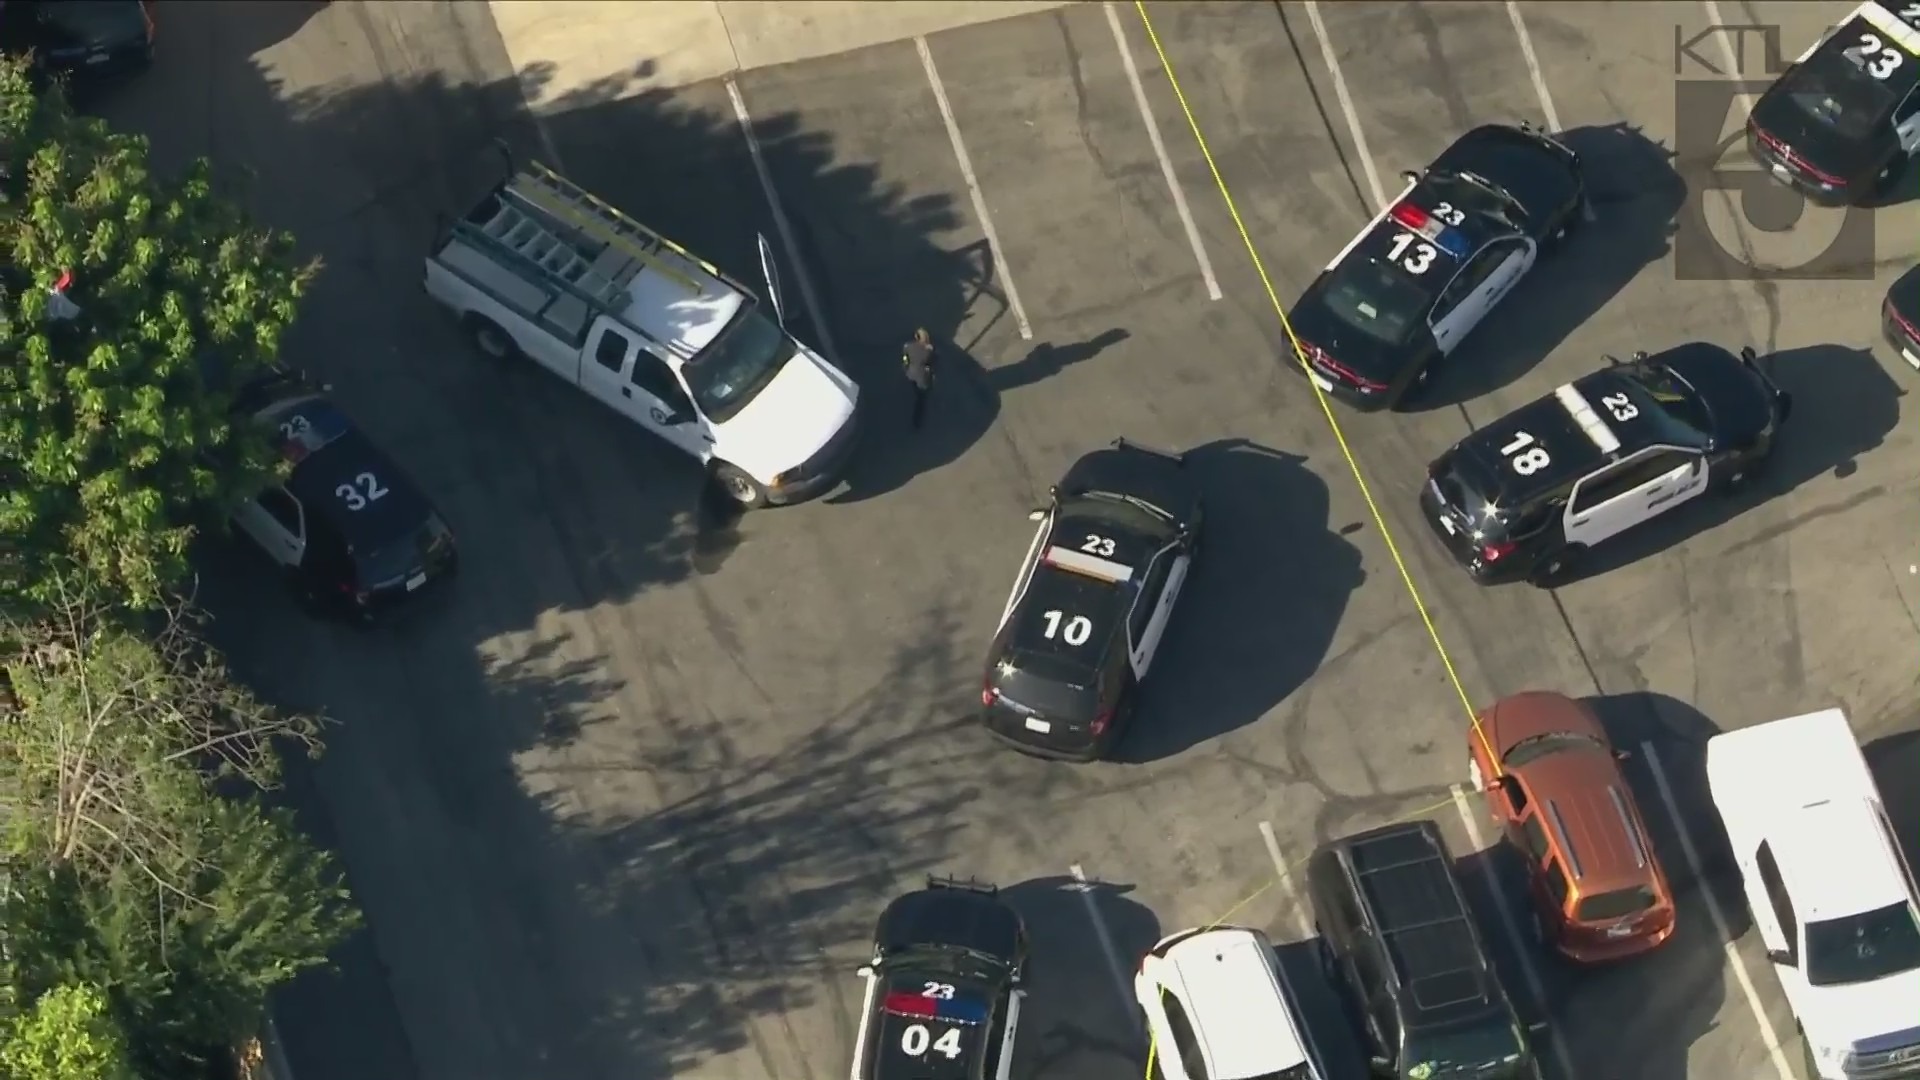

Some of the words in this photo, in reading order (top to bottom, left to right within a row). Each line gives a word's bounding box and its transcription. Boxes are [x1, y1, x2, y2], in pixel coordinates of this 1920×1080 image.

[1842, 33, 1903, 79] 23
[1432, 202, 1466, 226] 23
[1387, 233, 1437, 274] 13
[1602, 392, 1639, 422] 23
[279, 414, 311, 440] 23
[1500, 431, 1550, 475] 18
[335, 472, 389, 510] 32
[1081, 534, 1116, 557] 23
[1043, 609, 1093, 646] 10
[921, 981, 956, 1000] 23
[901, 1024, 962, 1060] 04
